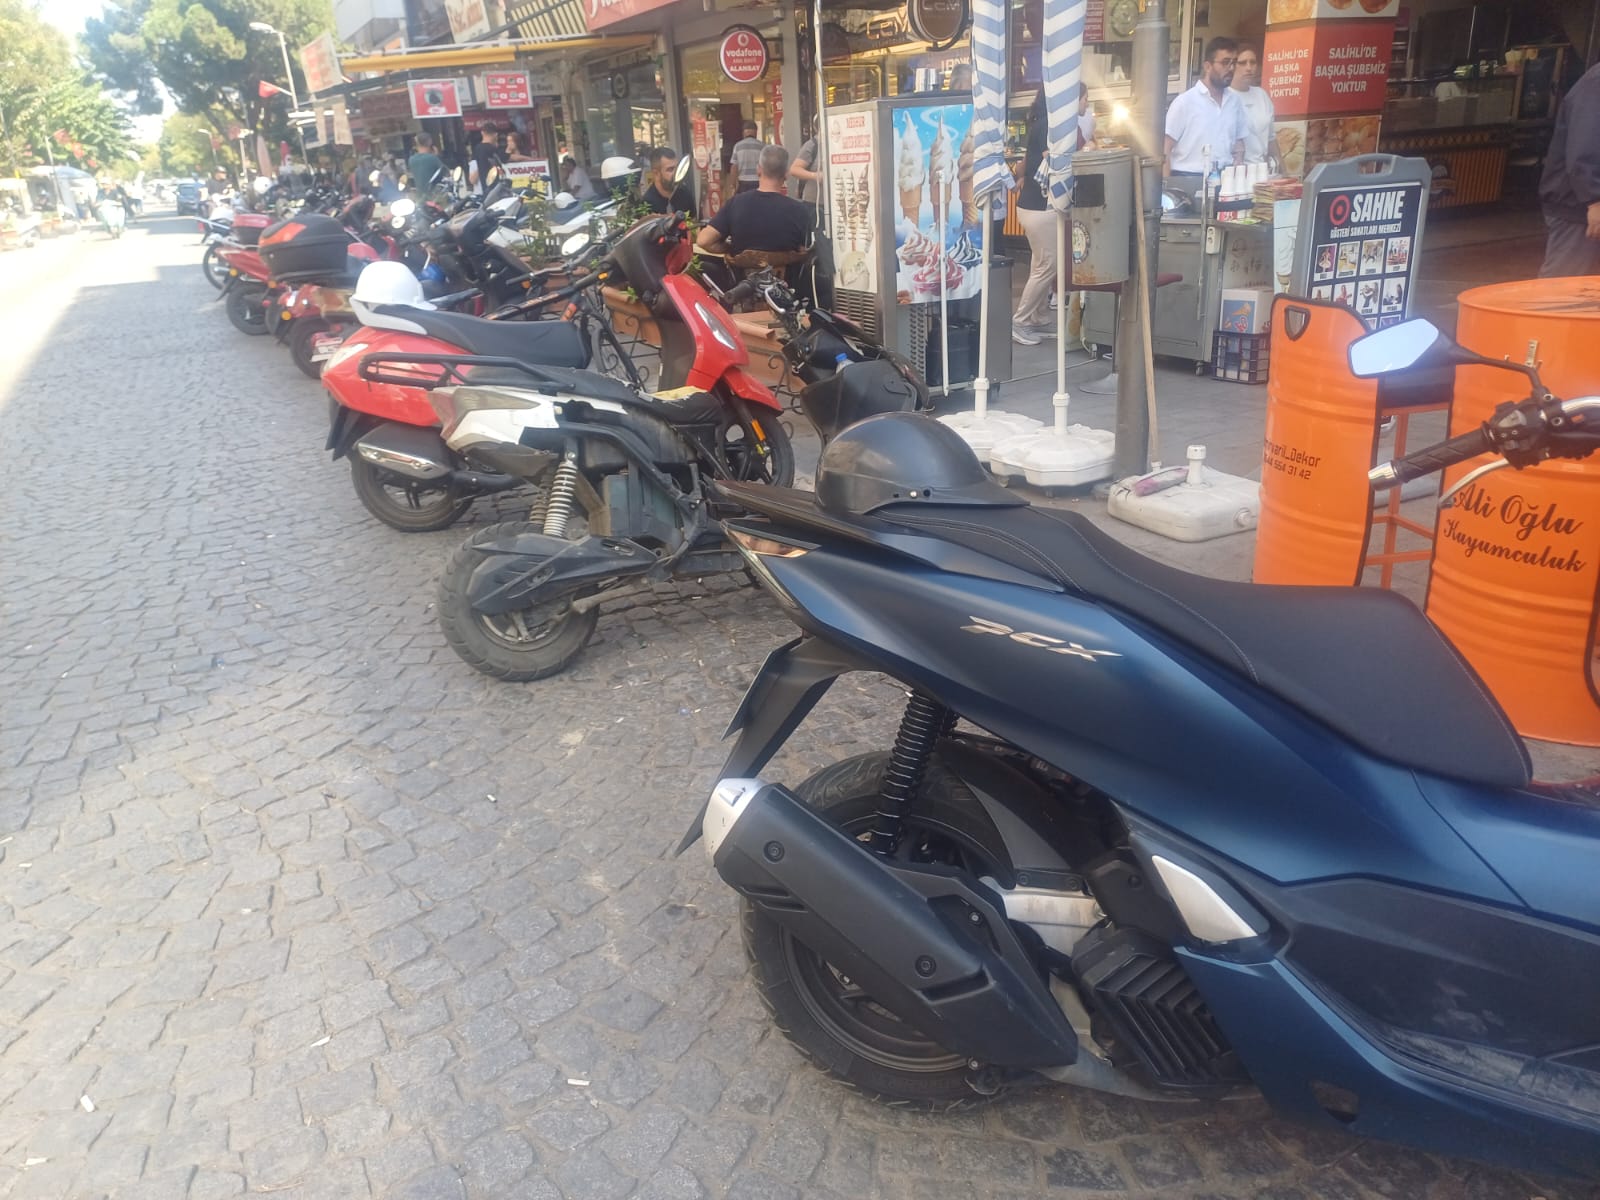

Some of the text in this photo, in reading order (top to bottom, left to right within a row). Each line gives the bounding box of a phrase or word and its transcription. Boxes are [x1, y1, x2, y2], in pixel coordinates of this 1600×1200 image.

[725, 47, 763, 57] vodafone
[1267, 48, 1310, 62] SALİHLİ'DE
[1329, 44, 1378, 59] SALİHLİ'DE
[1274, 63, 1299, 74] BAŞKA
[1315, 61, 1386, 79] BAŞKA ŞUBEMİZ
[1269, 73, 1304, 88] ŞUBEMİZ
[1331, 81, 1367, 93] YOKTUR
[1270, 87, 1301, 98] YOKTUR
[1350, 190, 1406, 223] SAHNE
[1454, 483, 1584, 541] Ali Oğlu
[1443, 518, 1586, 572] Kuyumculuk
[959, 615, 1124, 662] PCX
